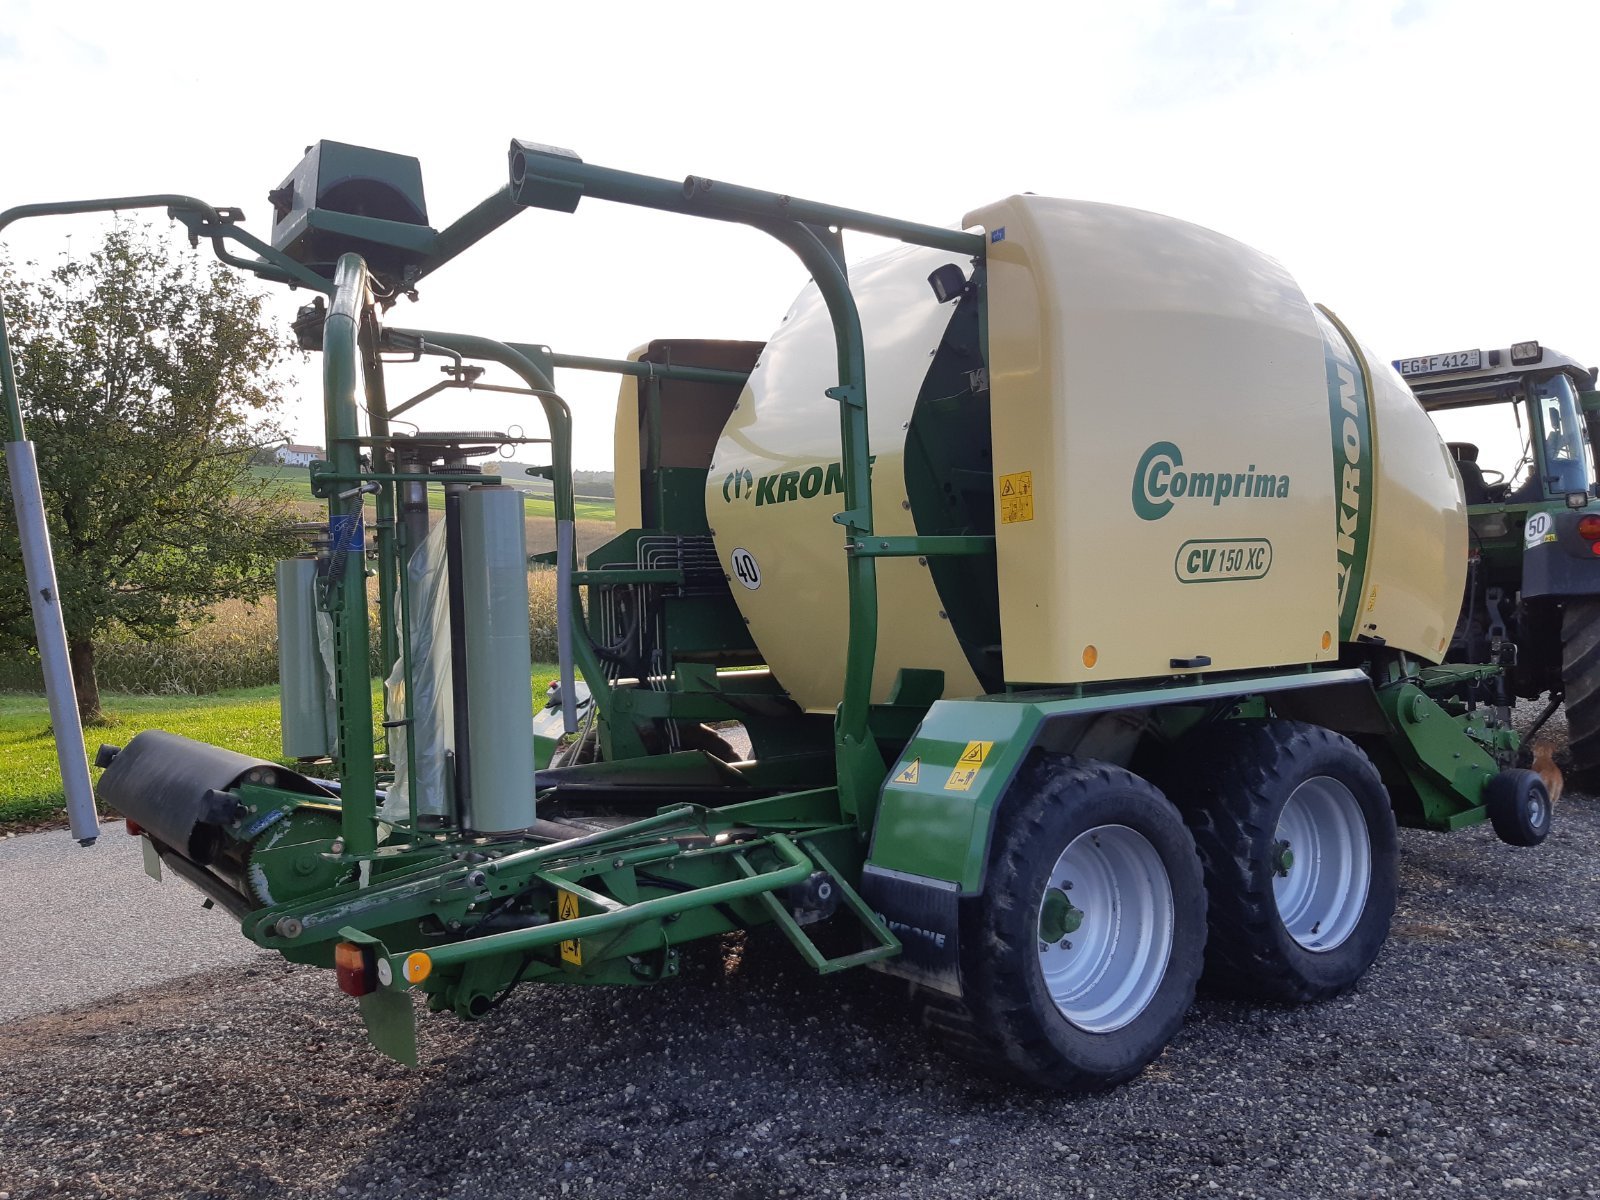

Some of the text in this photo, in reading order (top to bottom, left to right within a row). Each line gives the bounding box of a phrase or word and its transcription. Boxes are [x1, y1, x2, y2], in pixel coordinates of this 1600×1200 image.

[1401, 360, 1420, 374] EG
[1429, 357, 1439, 371] F
[1441, 353, 1469, 369] 412
[755, 455, 877, 507] KRON
[1528, 515, 1546, 538] 50
[734, 554, 759, 583] 40
[1186, 547, 1265, 574] CV 150 XC
